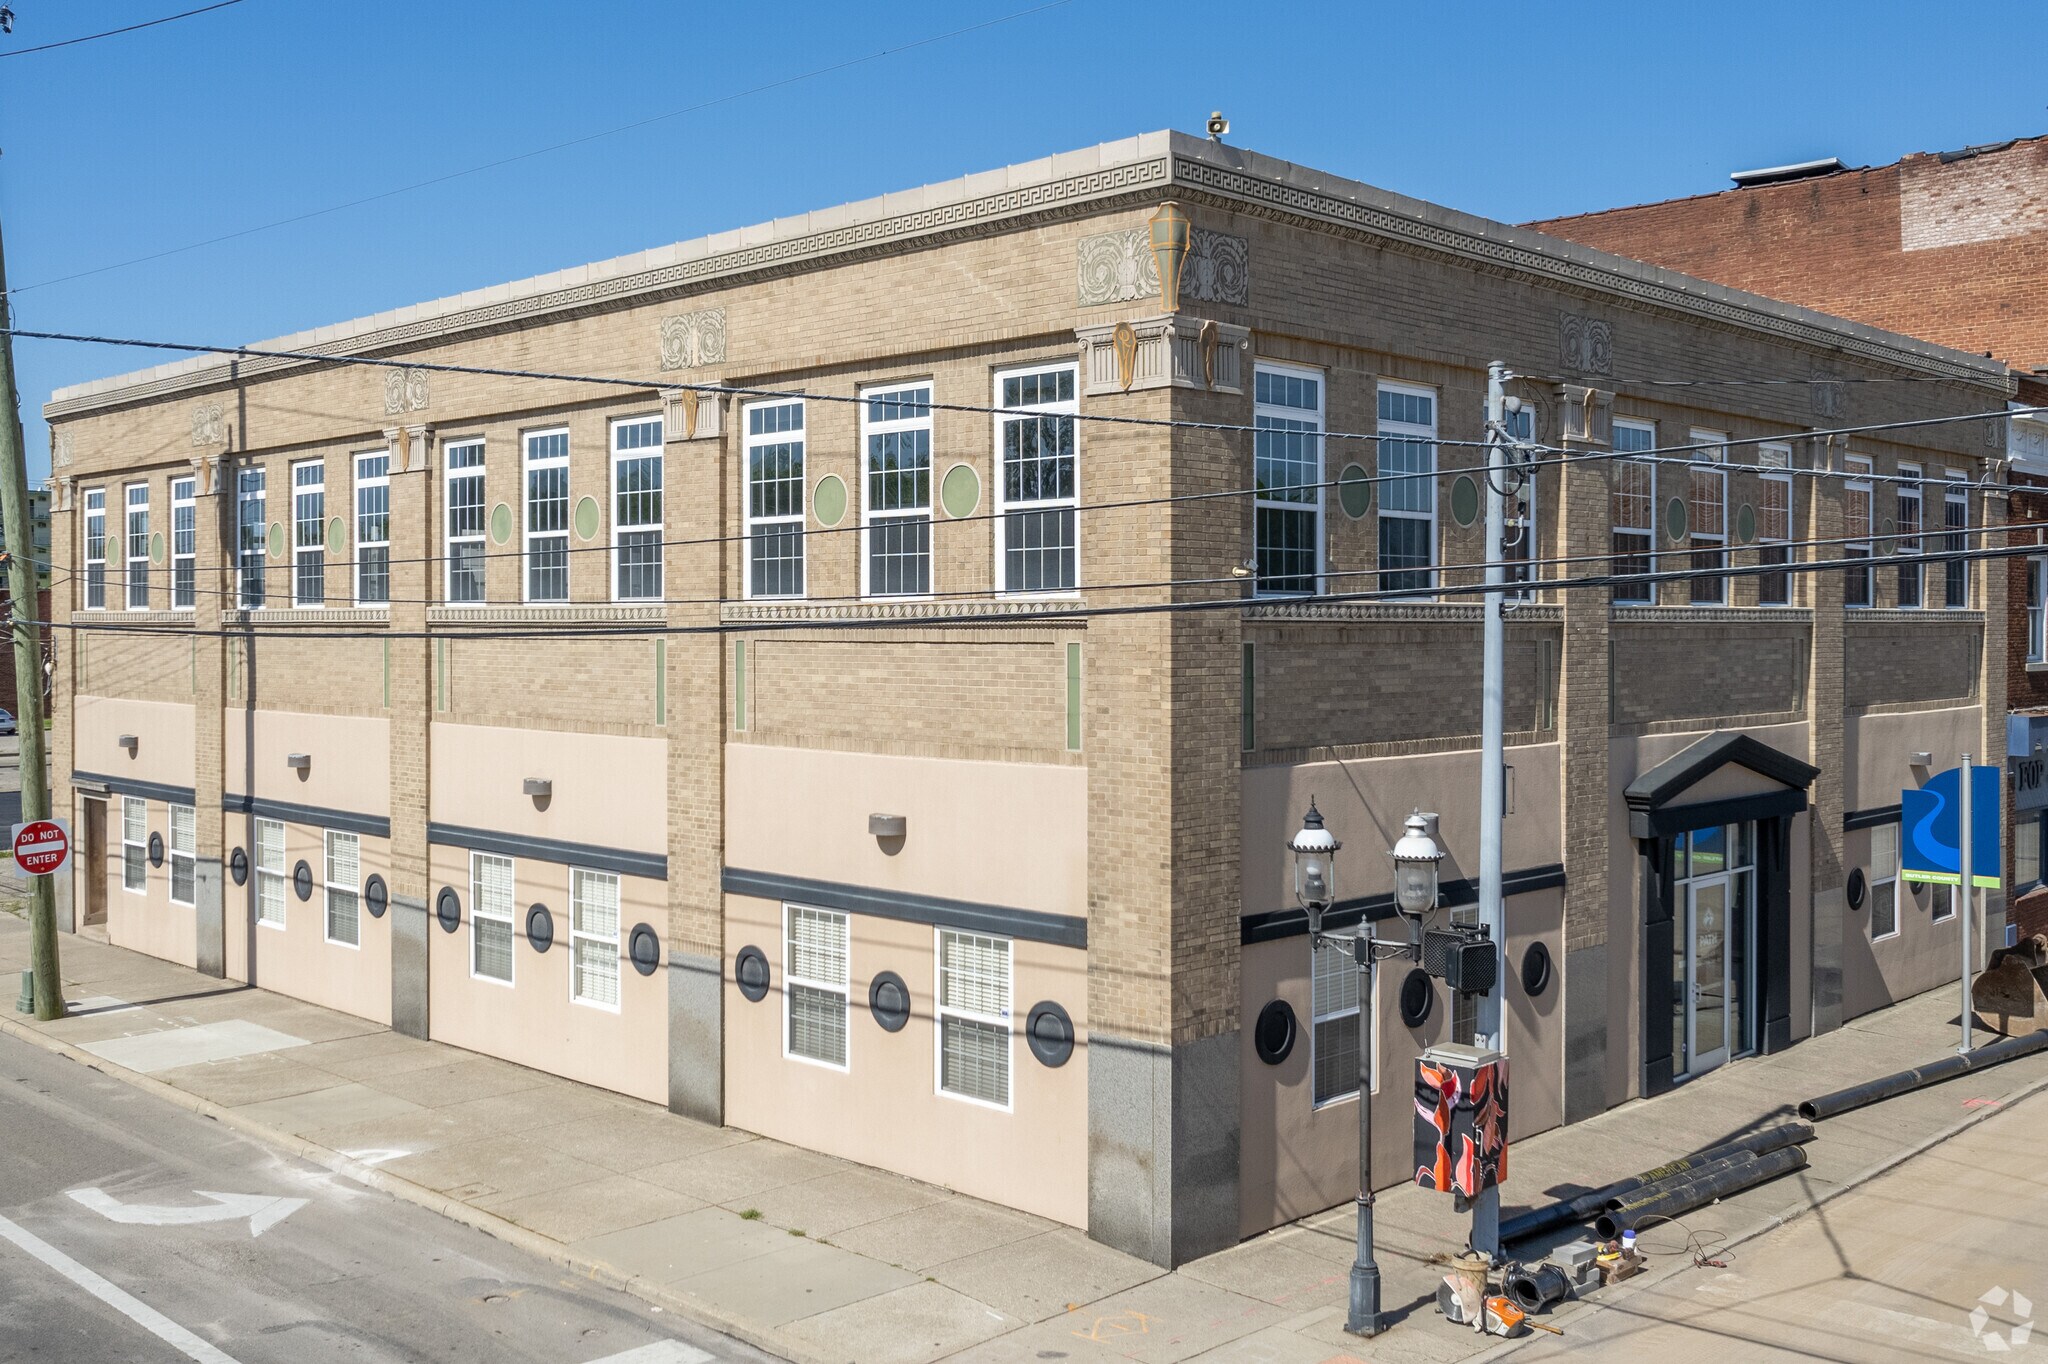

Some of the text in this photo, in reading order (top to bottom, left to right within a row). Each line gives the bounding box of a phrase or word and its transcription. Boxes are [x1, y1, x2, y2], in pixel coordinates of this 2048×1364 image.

[21, 829, 59, 843] DO NOT
[27, 853, 57, 866] ENTER
[1648, 1160, 1692, 1182] AMERICAN
